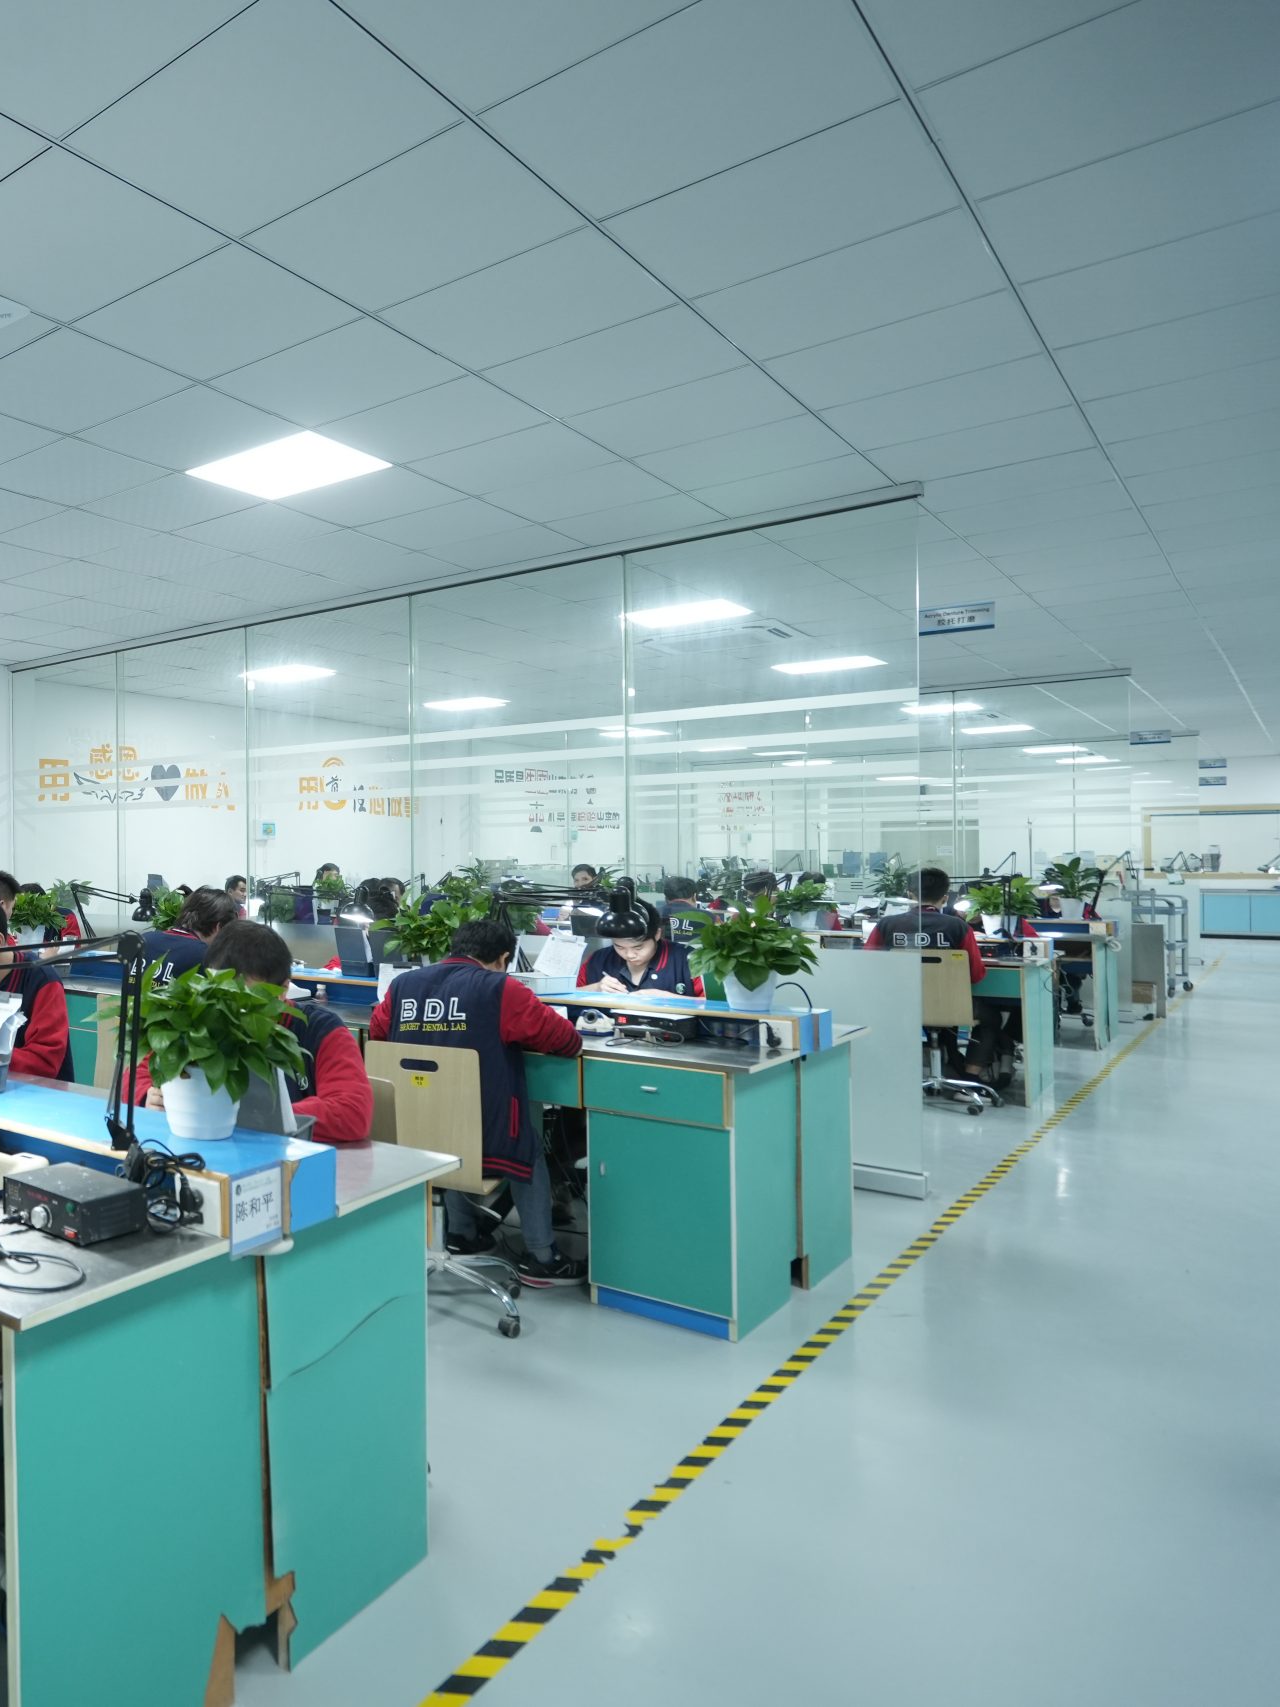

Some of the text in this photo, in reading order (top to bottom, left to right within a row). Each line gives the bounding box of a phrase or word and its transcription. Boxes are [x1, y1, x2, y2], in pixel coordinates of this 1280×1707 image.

[893, 932, 951, 947] BDL
[400, 997, 467, 1022] BDL
[422, 1022, 449, 1032] DENTAL
[451, 1022, 467, 1031] LAB
